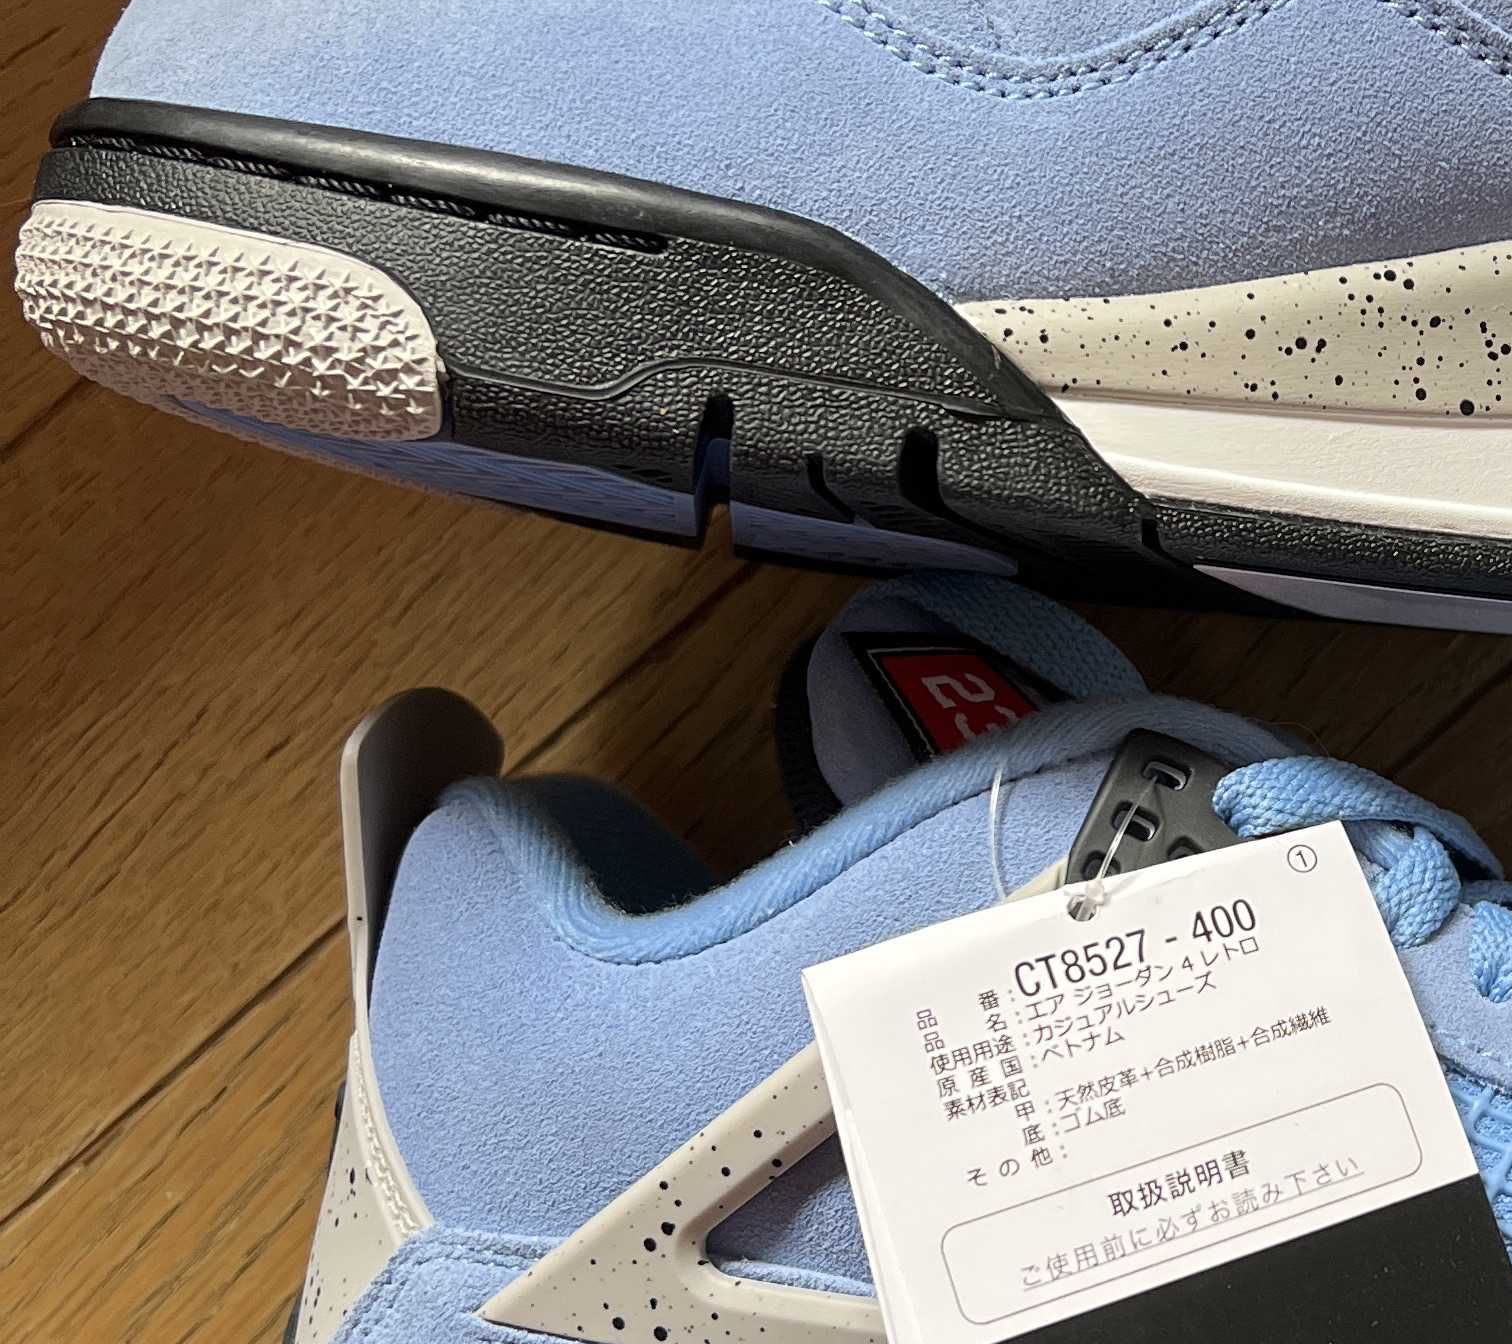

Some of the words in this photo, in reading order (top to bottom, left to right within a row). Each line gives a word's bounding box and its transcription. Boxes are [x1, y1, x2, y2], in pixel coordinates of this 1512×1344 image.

[943, 1077, 1032, 1122] 素材表記
[1106, 1148, 1252, 1218] 取扱説明書
[1019, 1156, 1360, 1288] ご使用前に必ずお読み下さい
